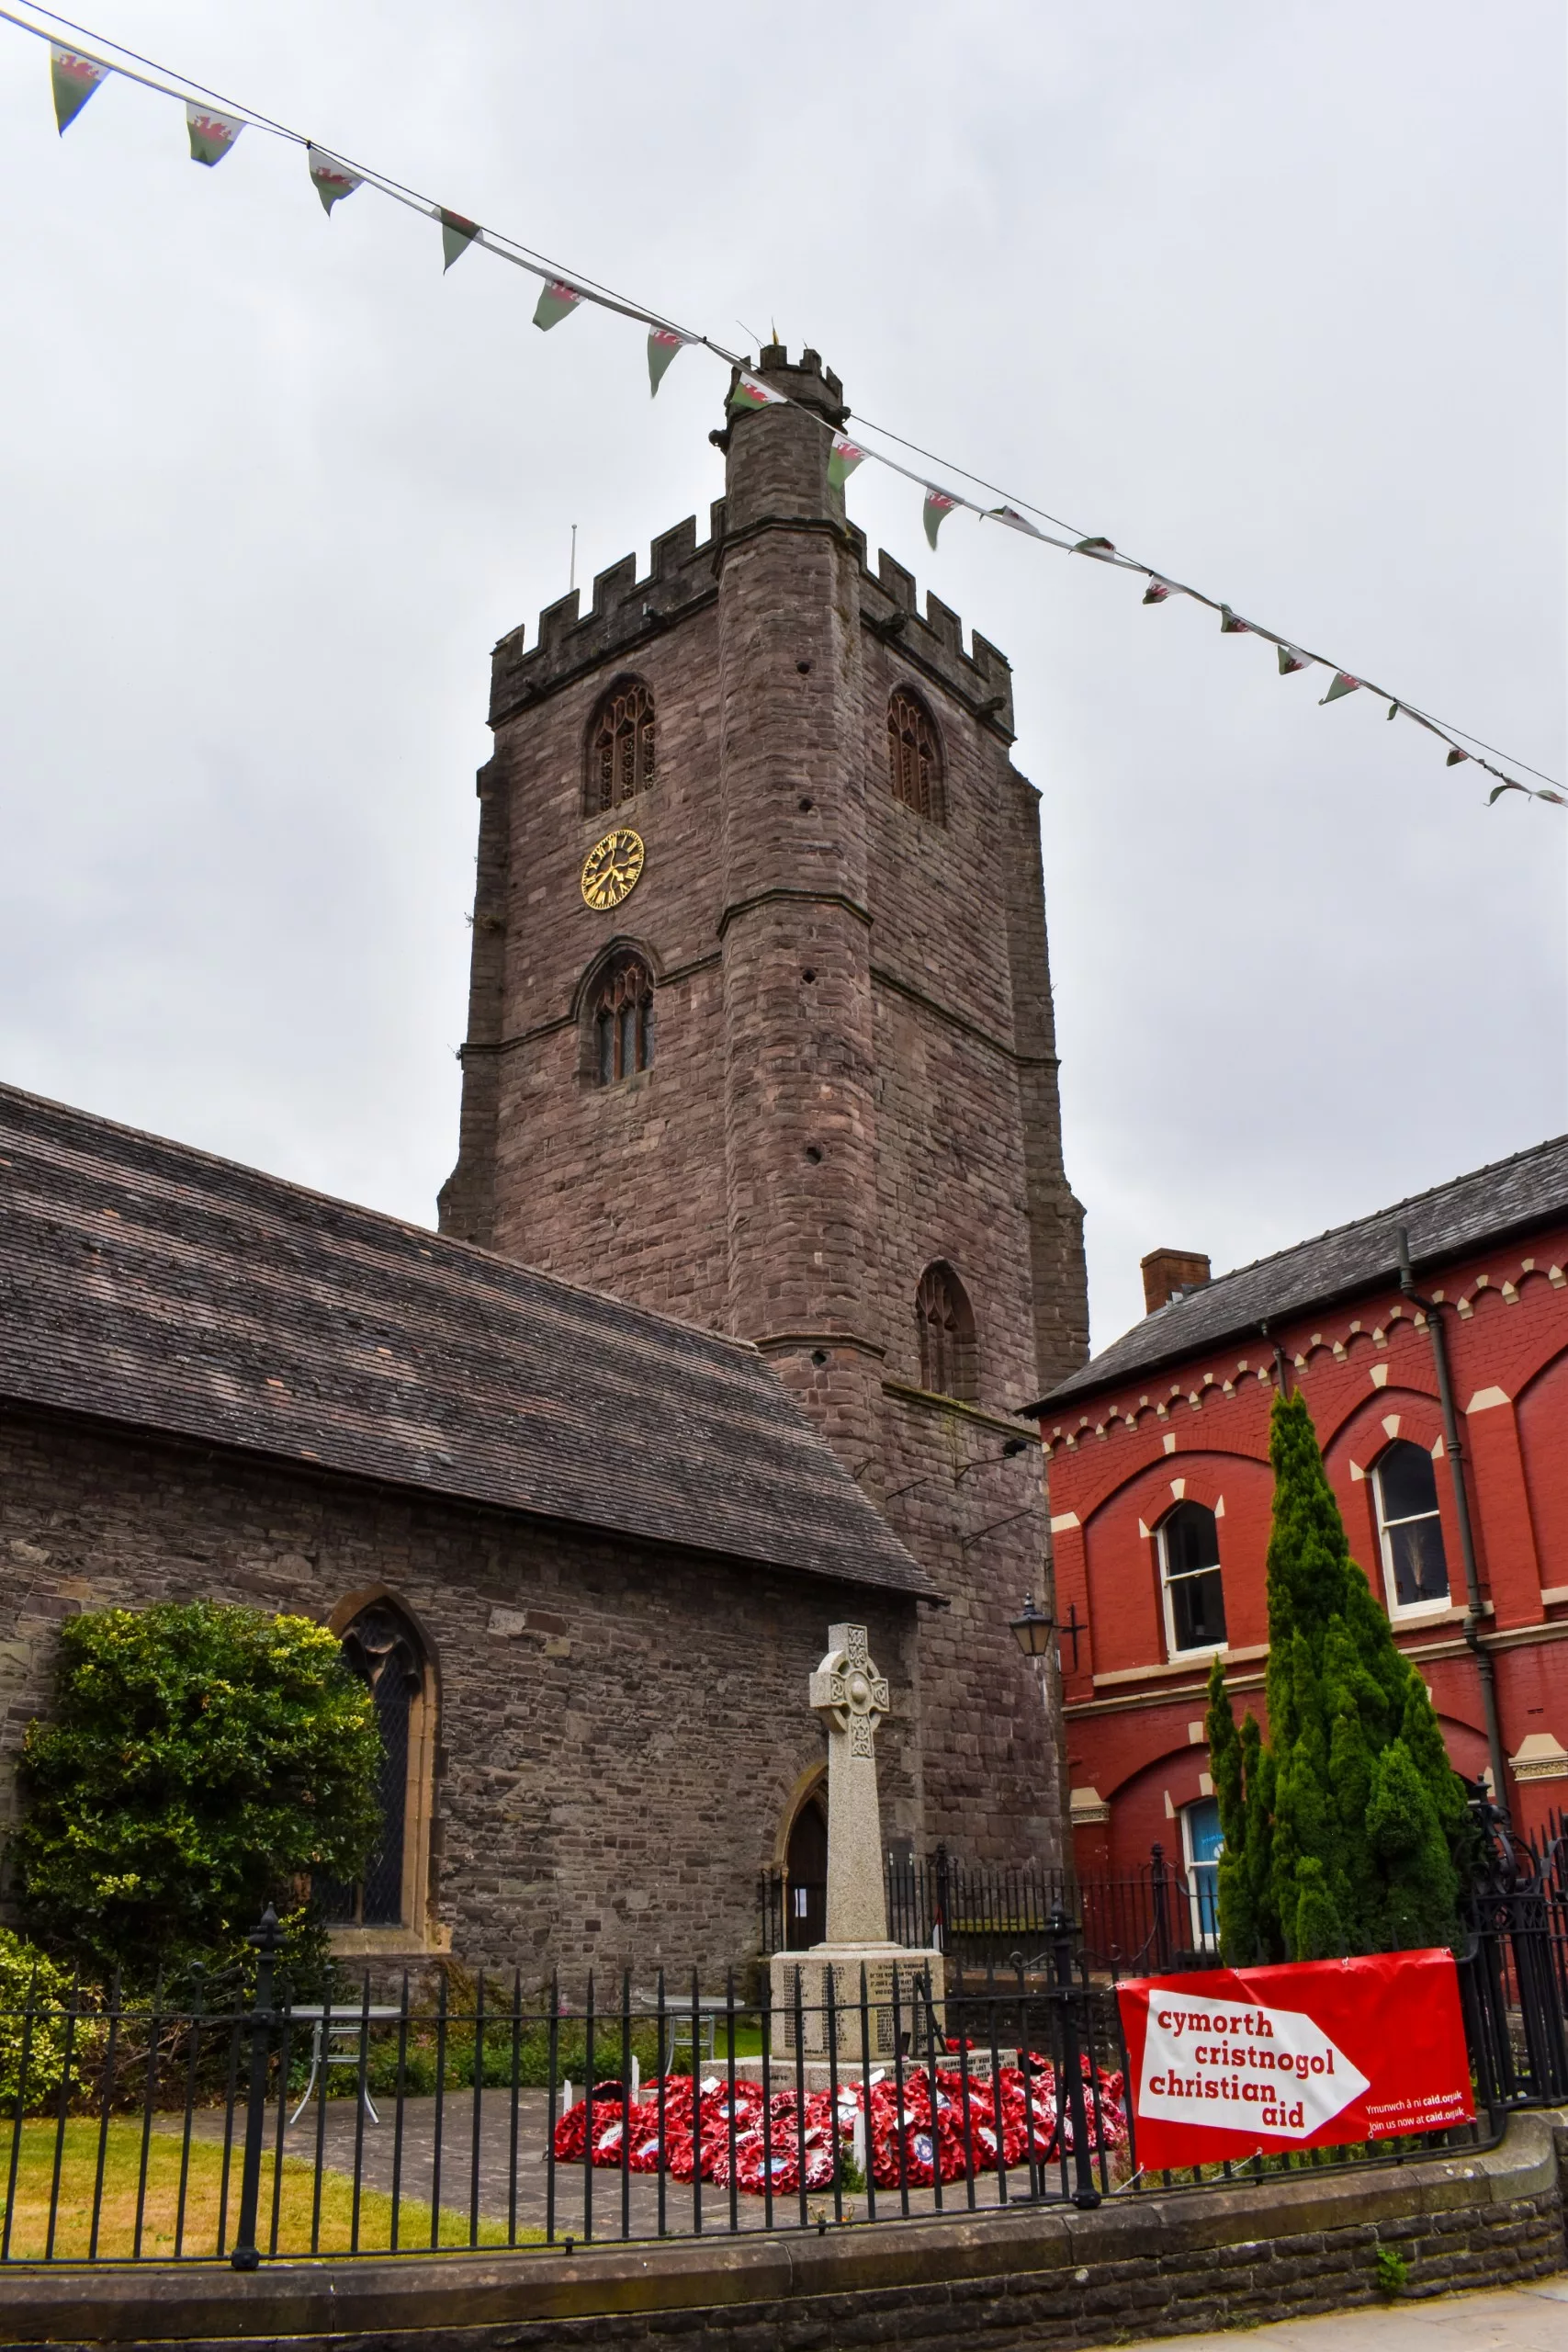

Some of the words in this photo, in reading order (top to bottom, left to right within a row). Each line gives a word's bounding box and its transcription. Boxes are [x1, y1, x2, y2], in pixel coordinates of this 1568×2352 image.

[1157, 2010, 1273, 2037] cymorth
[1195, 2040, 1336, 2080] cristnogol
[1149, 2069, 1276, 2103] christian
[1262, 2101, 1305, 2129] aid
[1366, 2099, 1405, 2115] Ymunwch
[1369, 2121, 1385, 2132] Join
[1386, 2120, 1396, 2129] us
[1398, 2119, 1415, 2128] now
[1416, 2116, 1426, 2125] at
